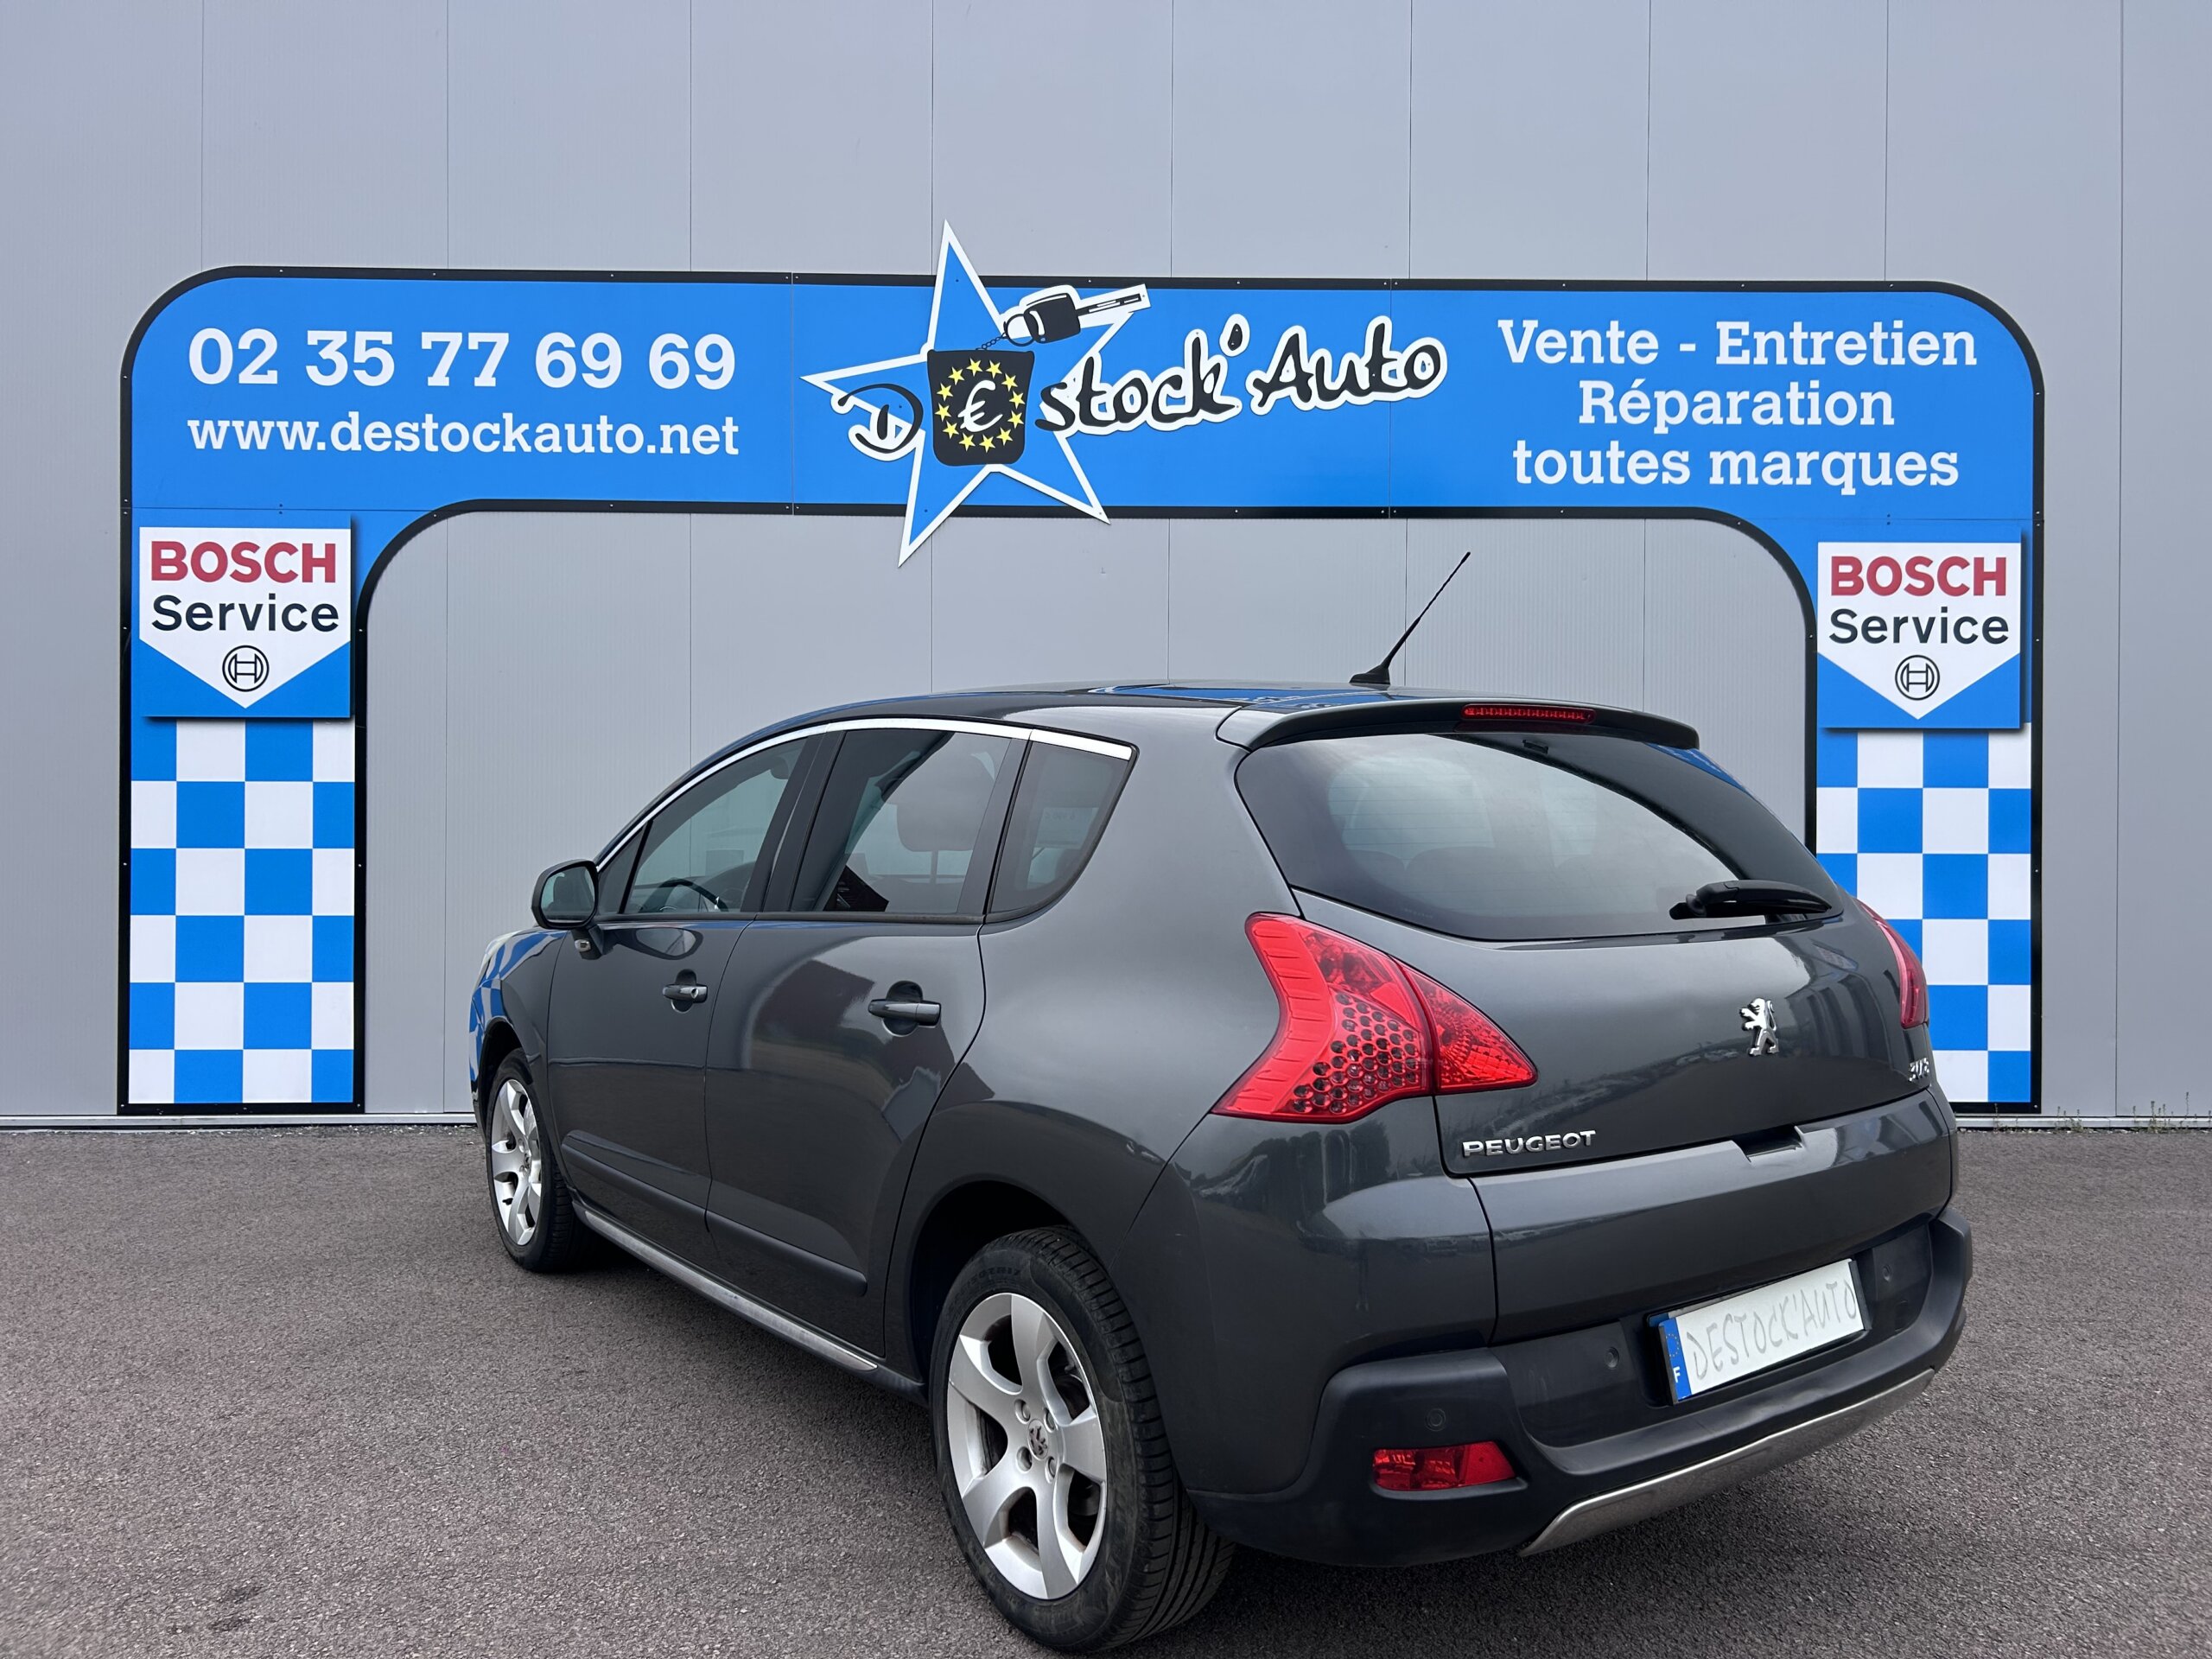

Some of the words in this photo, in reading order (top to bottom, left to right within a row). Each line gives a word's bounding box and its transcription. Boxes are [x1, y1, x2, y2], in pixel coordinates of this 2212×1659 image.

[188, 327, 278, 385] 02
[305, 330, 395, 387] 35
[421, 332, 510, 387] 77
[535, 332, 622, 389] 69
[649, 334, 735, 391] 69
[1497, 319, 1659, 365] Vente
[1716, 320, 1977, 366] Entretien
[1579, 378, 1895, 435] Réparation
[187, 410, 740, 455] www.destockauto.net
[1512, 440, 1691, 485] toutes
[1709, 450, 1959, 496] marques
[150, 540, 337, 583] BOSCH
[1830, 556, 2007, 597] BOSCH
[151, 593, 340, 632] Service
[1828, 606, 2009, 645] Service
[1462, 1129, 1597, 1157] PEUGEOT
[1686, 1279, 1858, 1381] DESTOCK'AUTO
[1672, 1366, 1681, 1383] F
